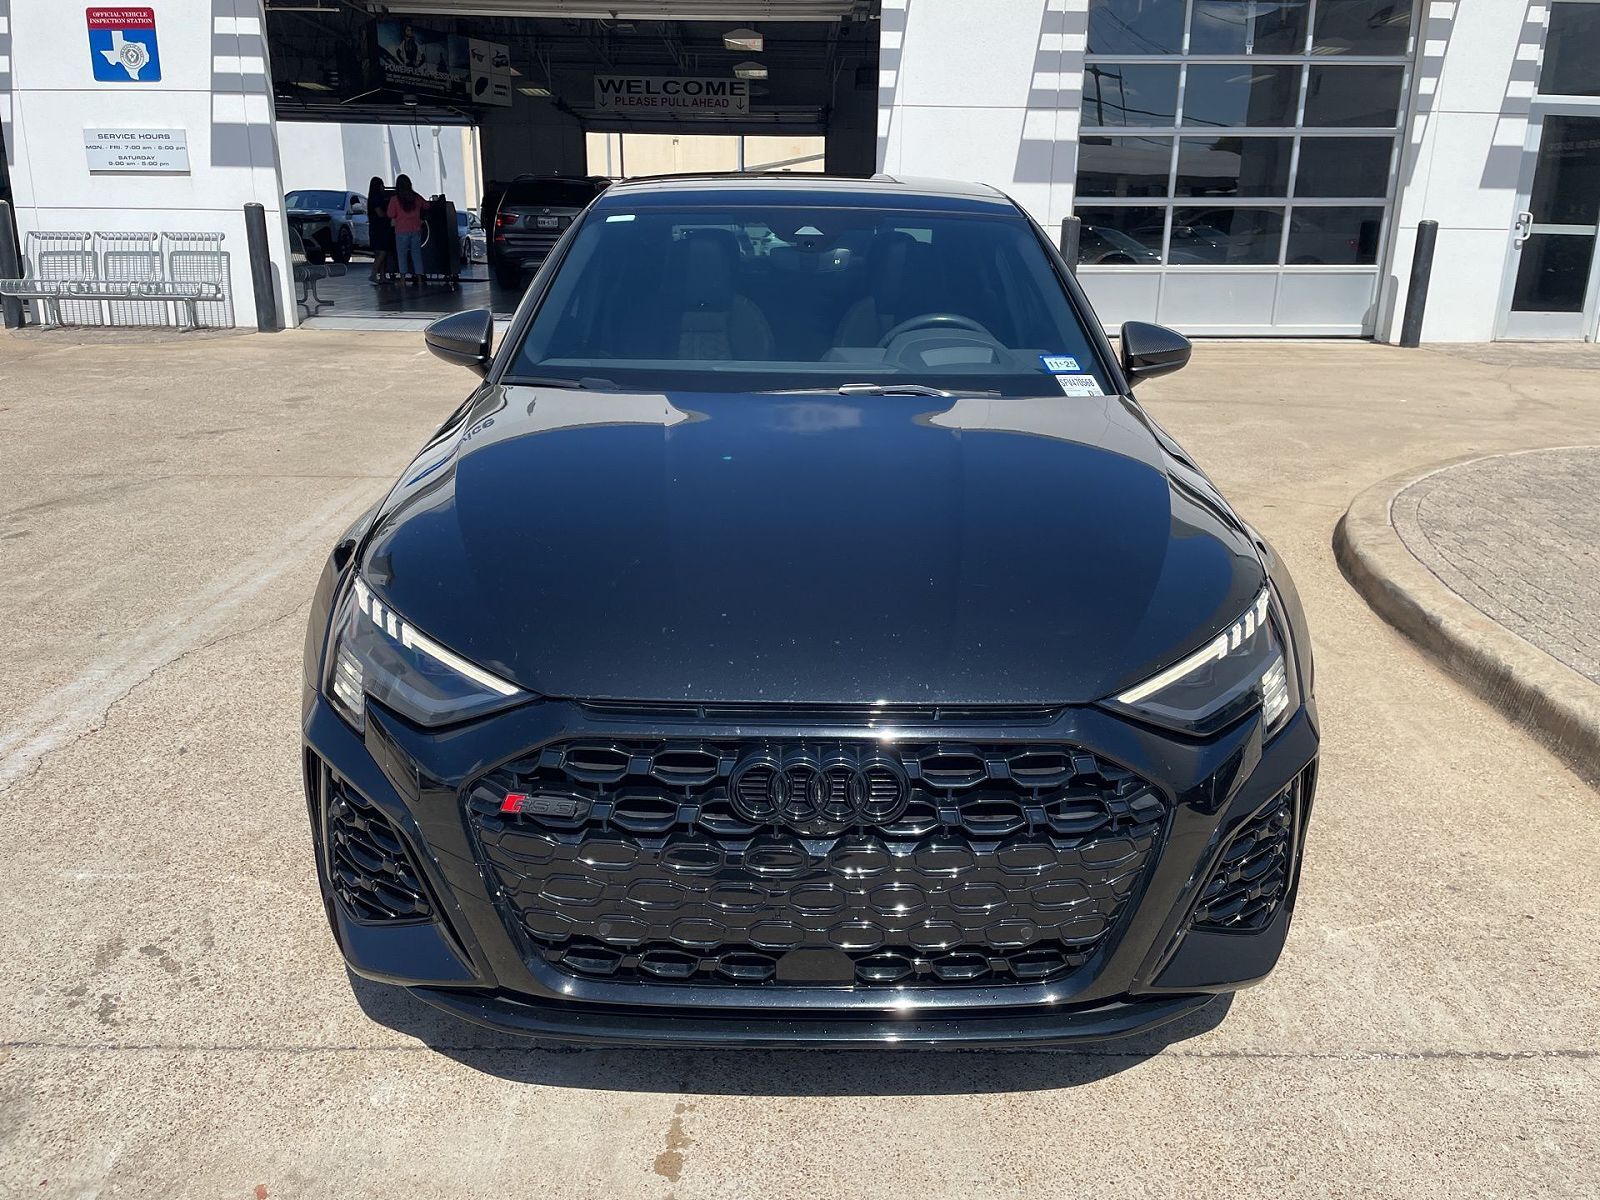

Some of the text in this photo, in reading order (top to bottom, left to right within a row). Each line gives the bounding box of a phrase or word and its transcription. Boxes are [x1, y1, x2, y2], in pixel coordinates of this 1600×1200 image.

[597, 79, 746, 96] WELCOME
[614, 96, 729, 108] PLEASE PULL AHEAD
